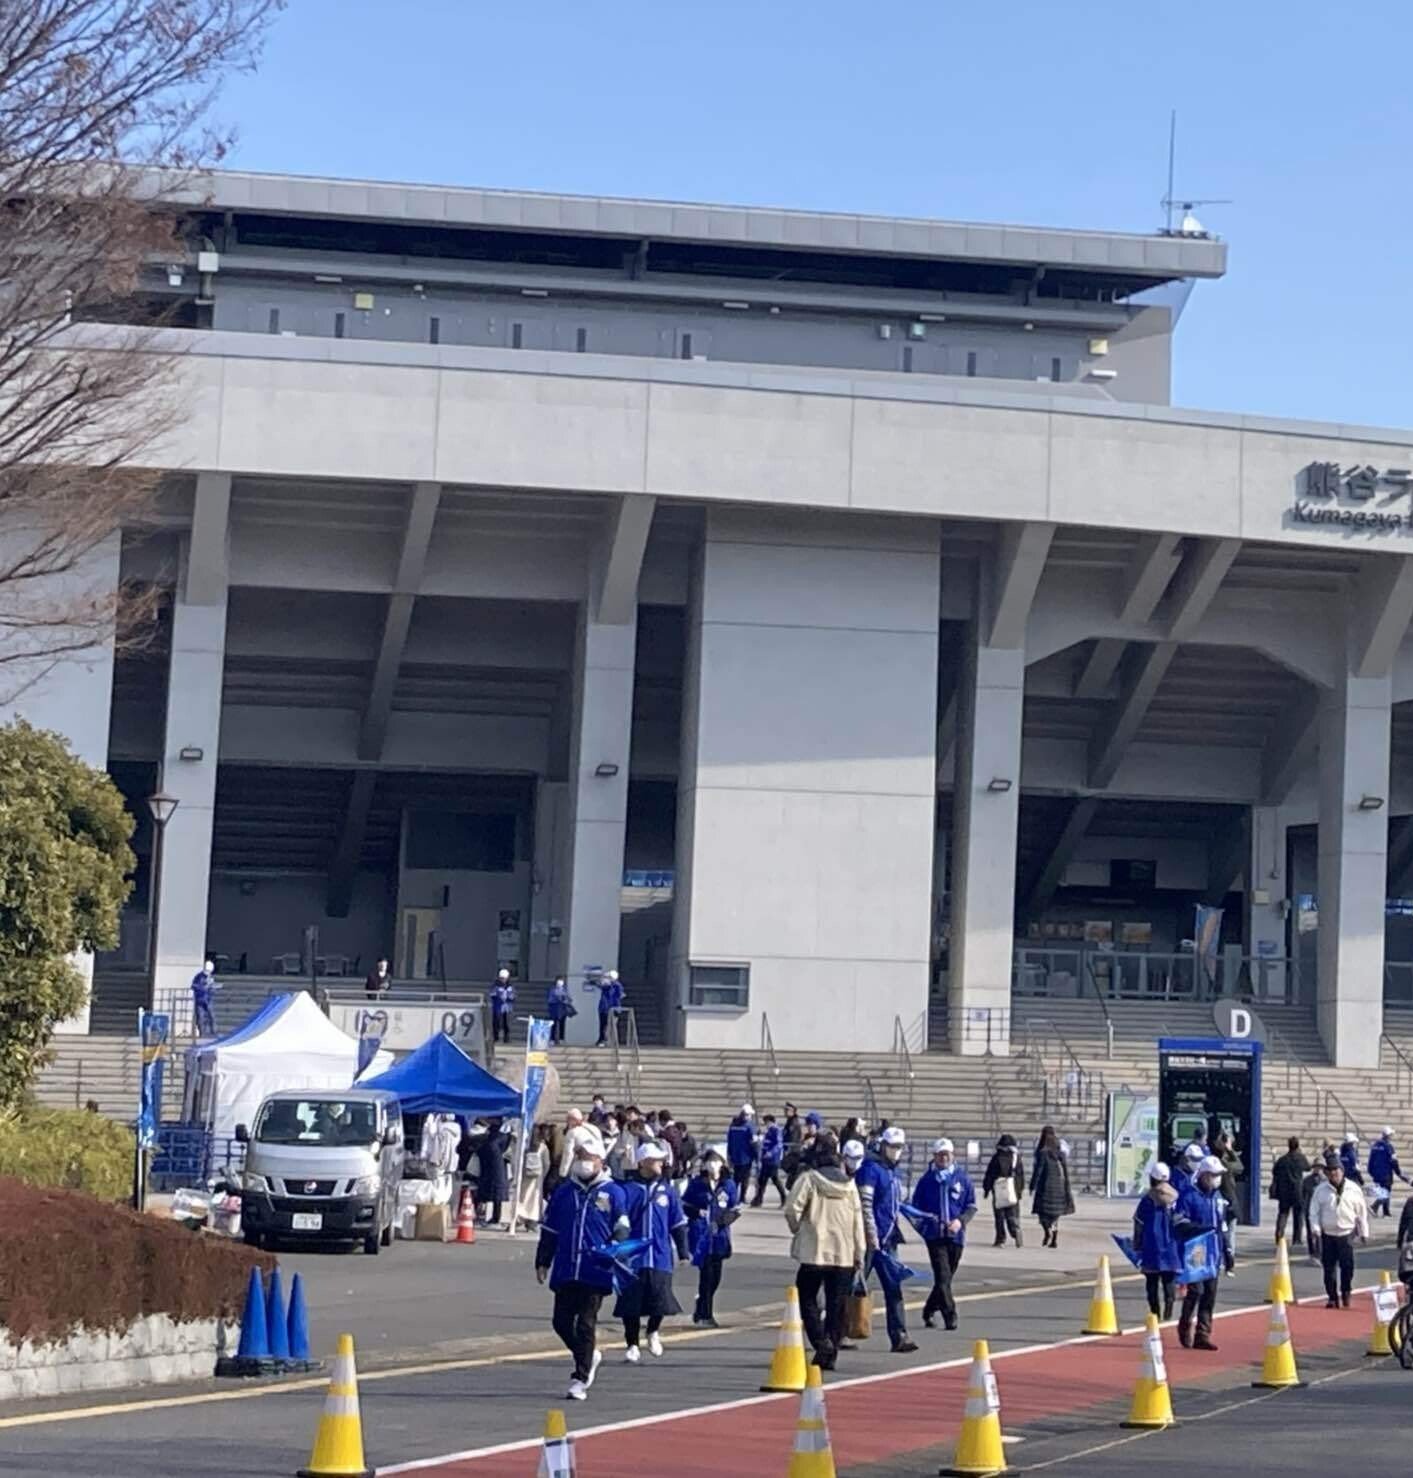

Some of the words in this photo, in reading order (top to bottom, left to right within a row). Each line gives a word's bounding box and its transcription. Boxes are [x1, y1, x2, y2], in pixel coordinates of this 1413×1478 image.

[1293, 501, 1402, 533] Kumagaya
[442, 1011, 475, 1037] 09
[1230, 1009, 1252, 1038] D
